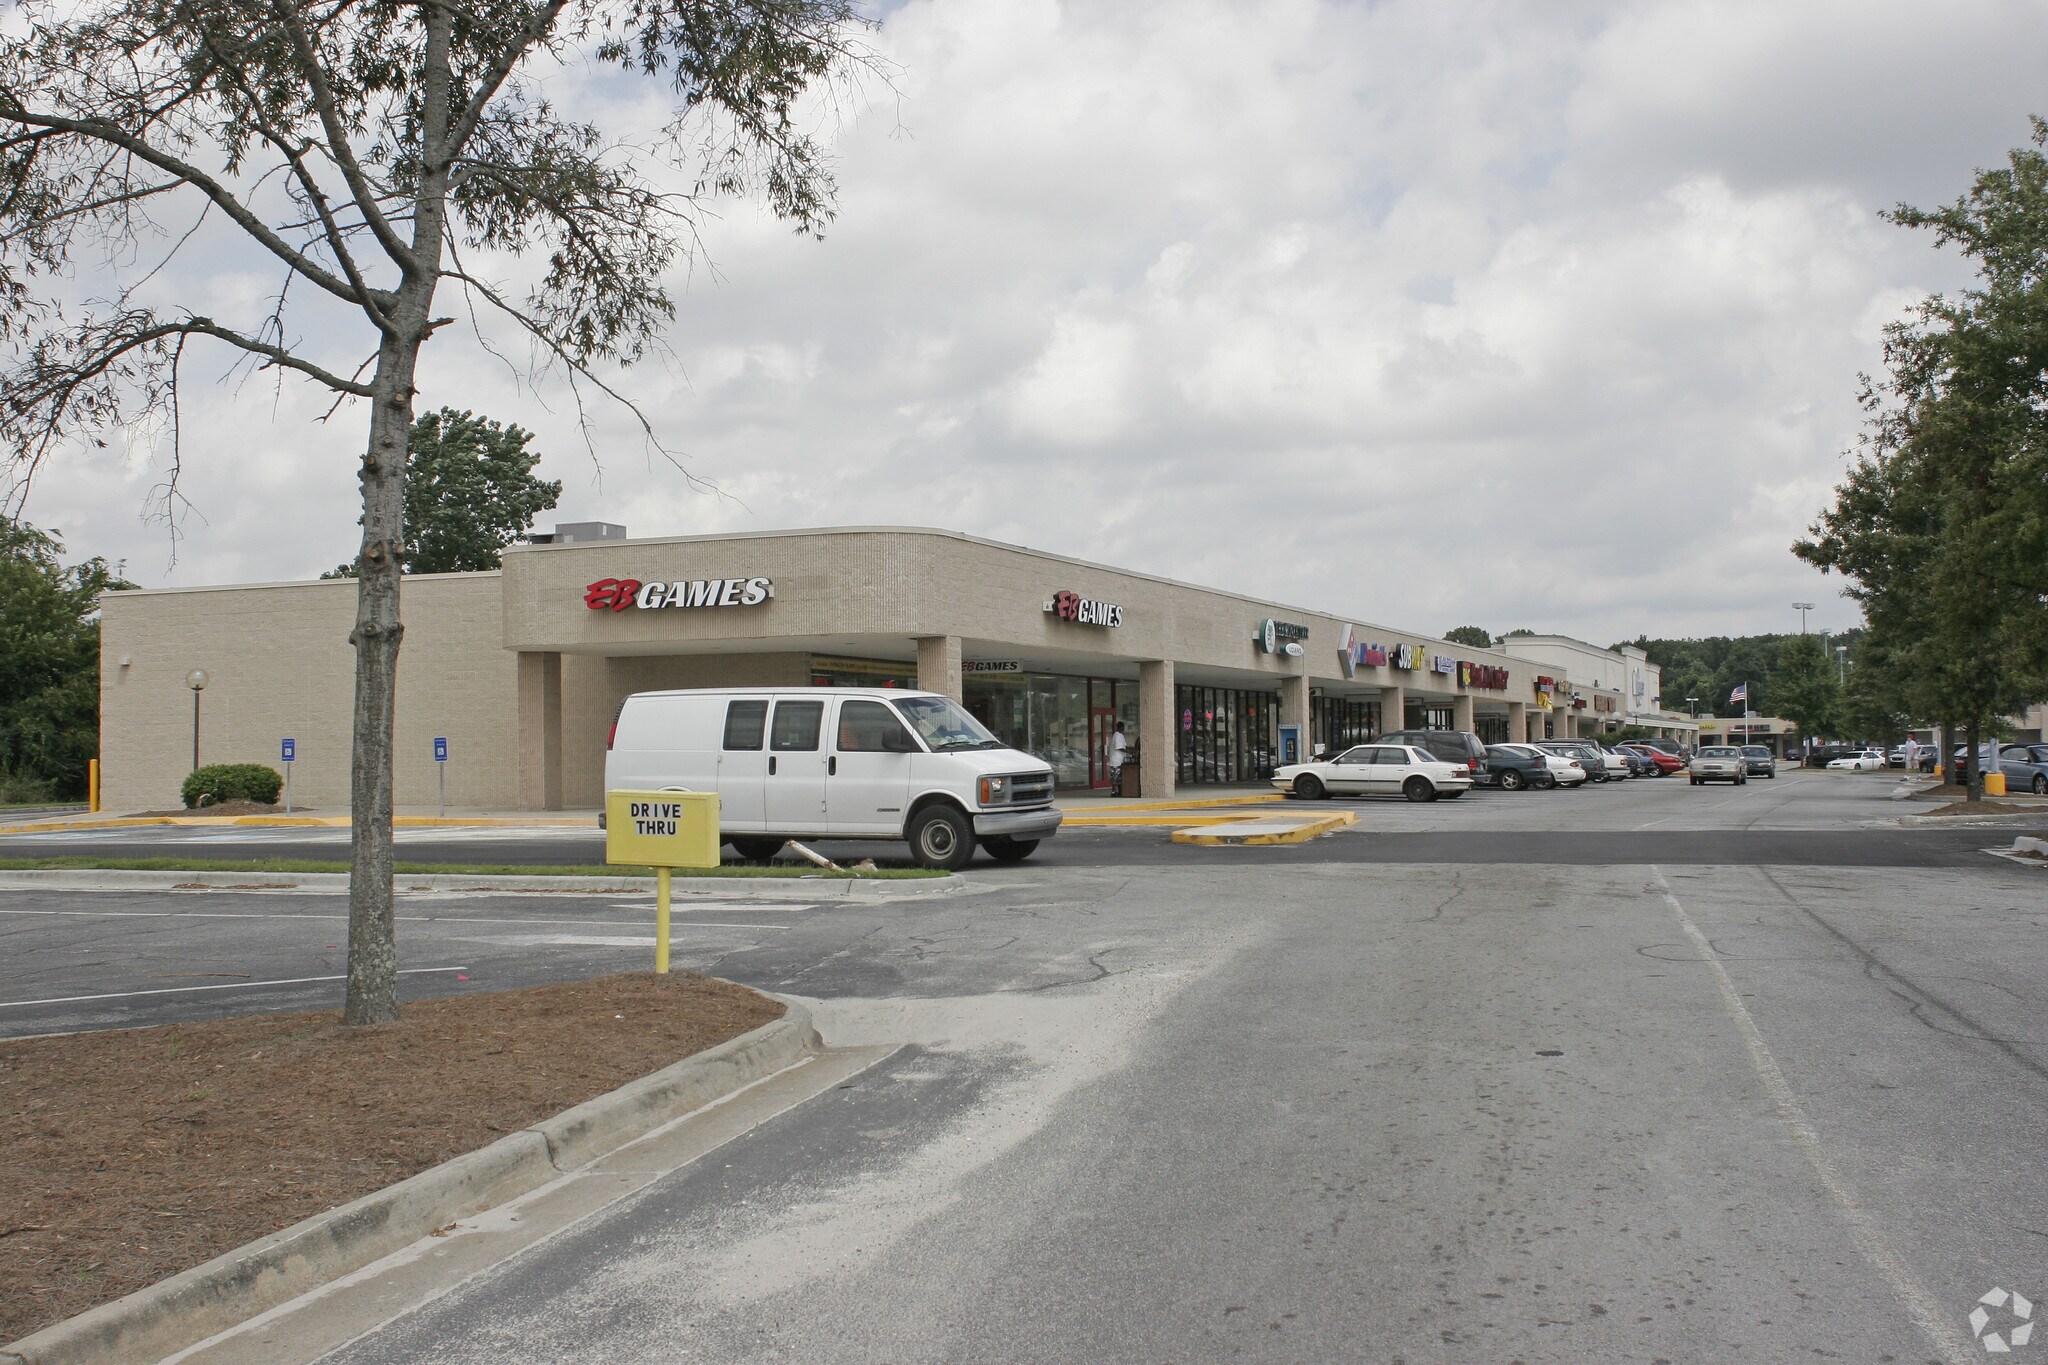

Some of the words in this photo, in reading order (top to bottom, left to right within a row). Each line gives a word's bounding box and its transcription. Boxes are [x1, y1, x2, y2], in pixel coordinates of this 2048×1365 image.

[976, 661, 1018, 671] GAMES
[631, 803, 681, 818] DRIVE
[636, 820, 676, 835] THRU
